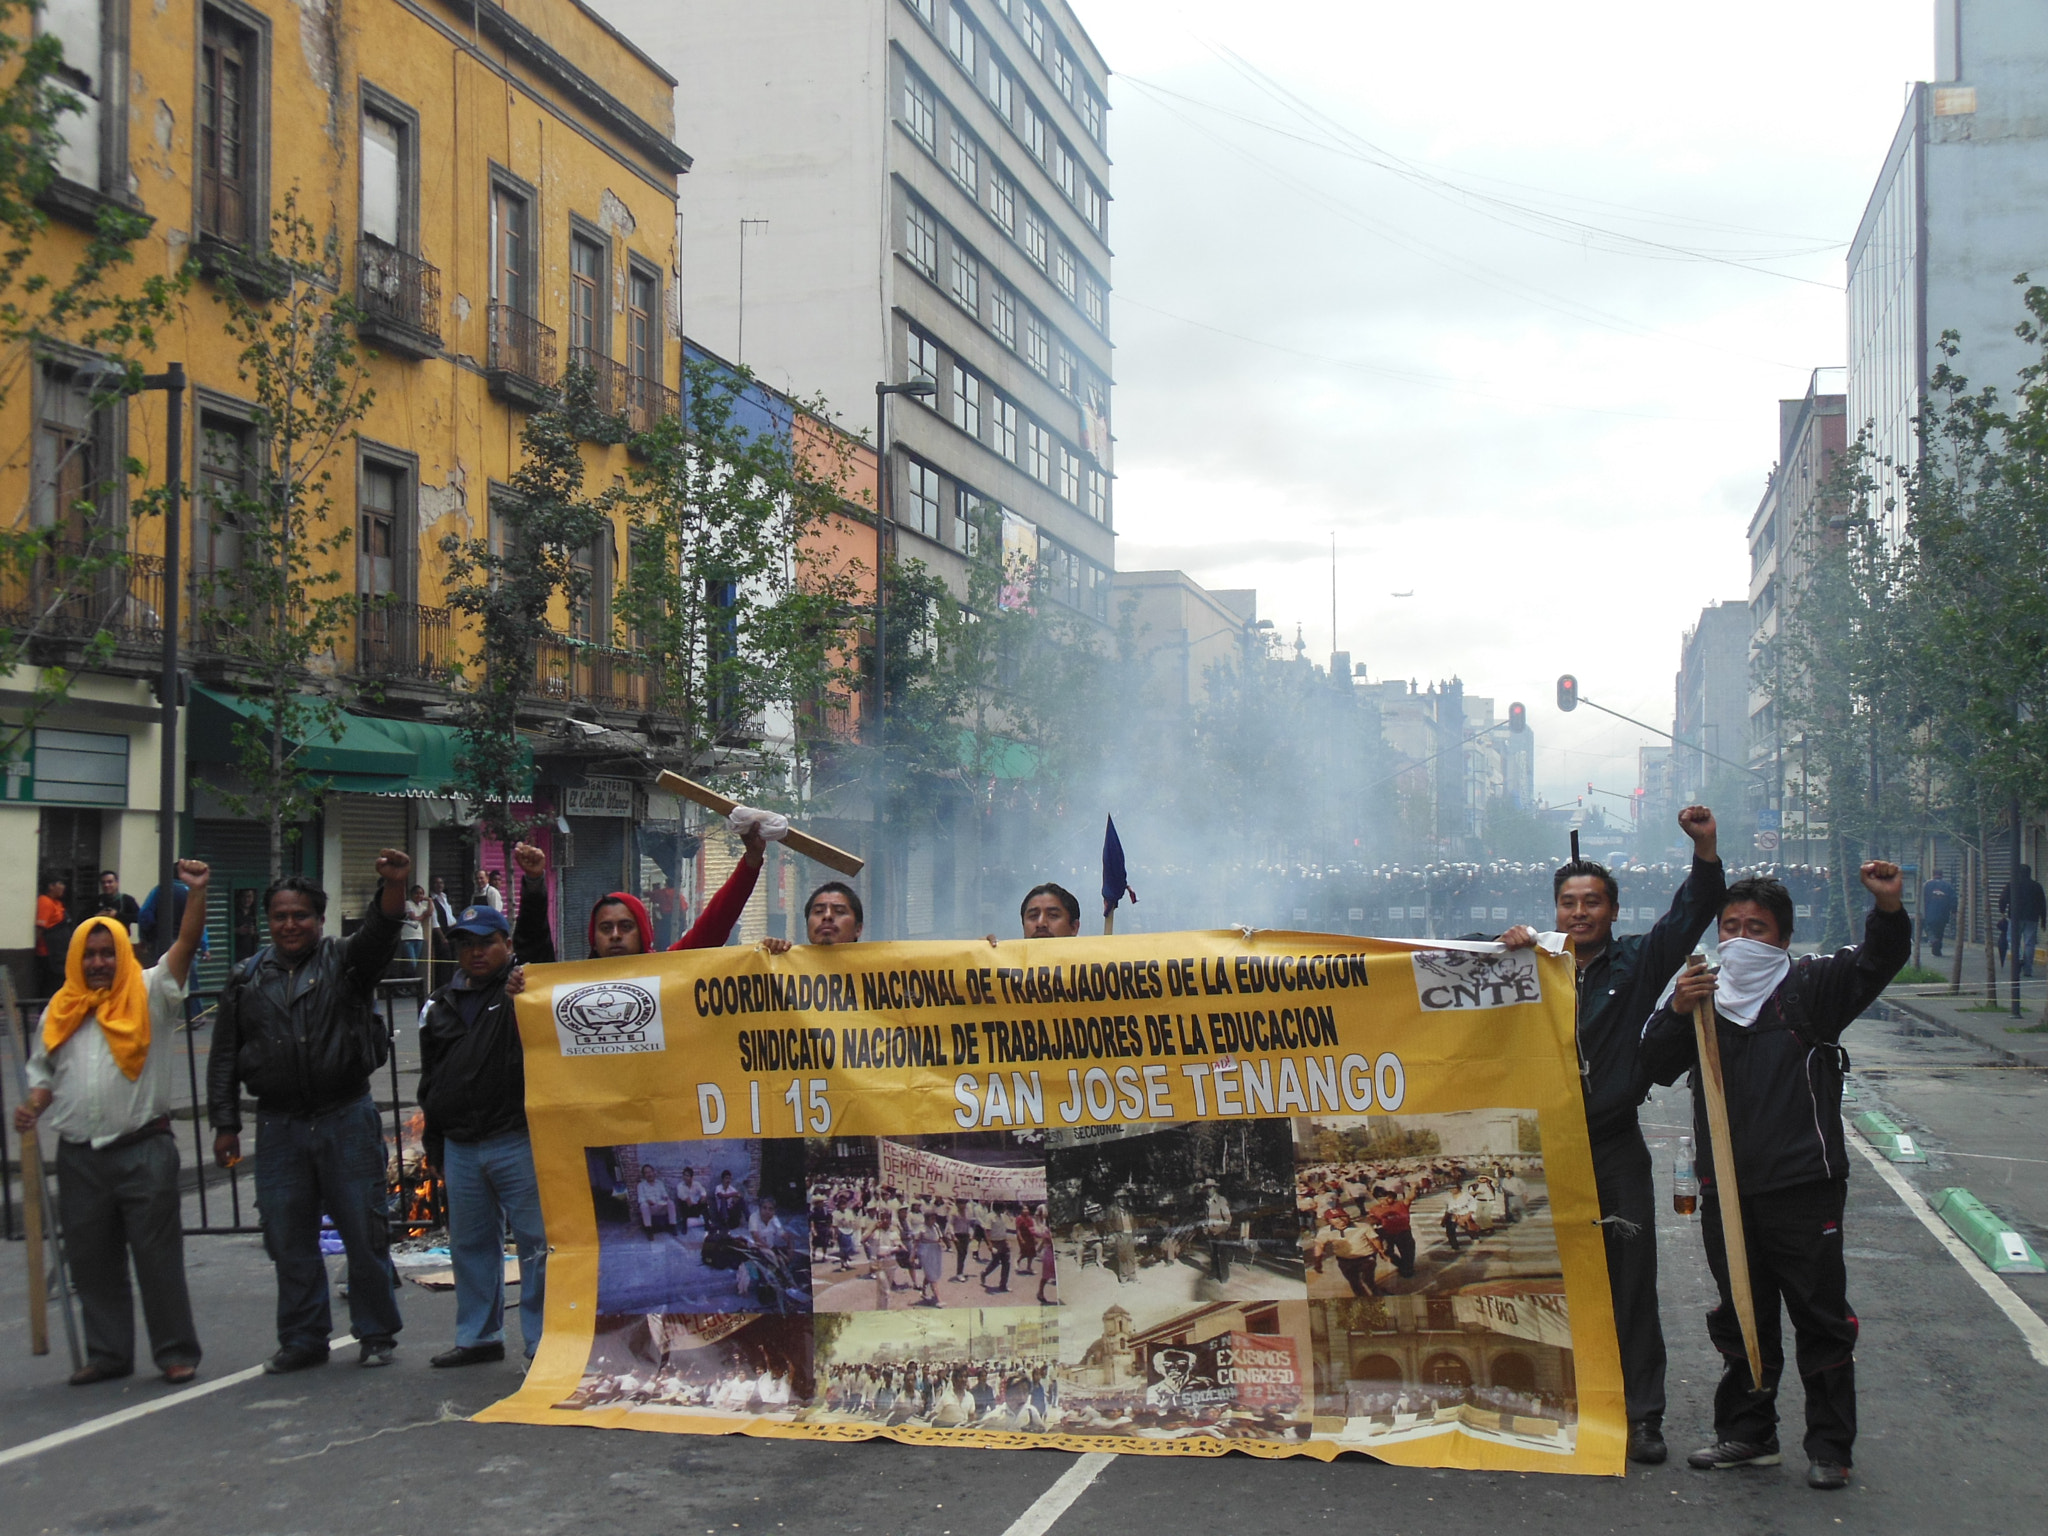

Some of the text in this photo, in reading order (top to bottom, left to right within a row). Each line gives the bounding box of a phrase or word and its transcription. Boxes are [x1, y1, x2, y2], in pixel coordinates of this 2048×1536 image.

[694, 953, 1369, 1017] COORDINADORA NACIONAL DE TRABAJADORES DE LA EDUCACION
[1420, 977, 1540, 1009] CNTE
[566, 1043, 660, 1055] SECCION XXII
[583, 1034, 636, 1043] SNTE
[738, 1005, 1339, 1072] SINDICATO NACIONAL DE TRABAJADORES DE LA EDUCACION
[953, 1052, 1406, 1128] SAN JOSE TENANGO
[696, 1082, 726, 1135] D
[785, 1078, 832, 1133] 15
[1073, 1124, 1124, 1140] SECCIONAL
[702, 1313, 746, 1341] CONGRESO
[1217, 1367, 1295, 1385] CONGRESO
